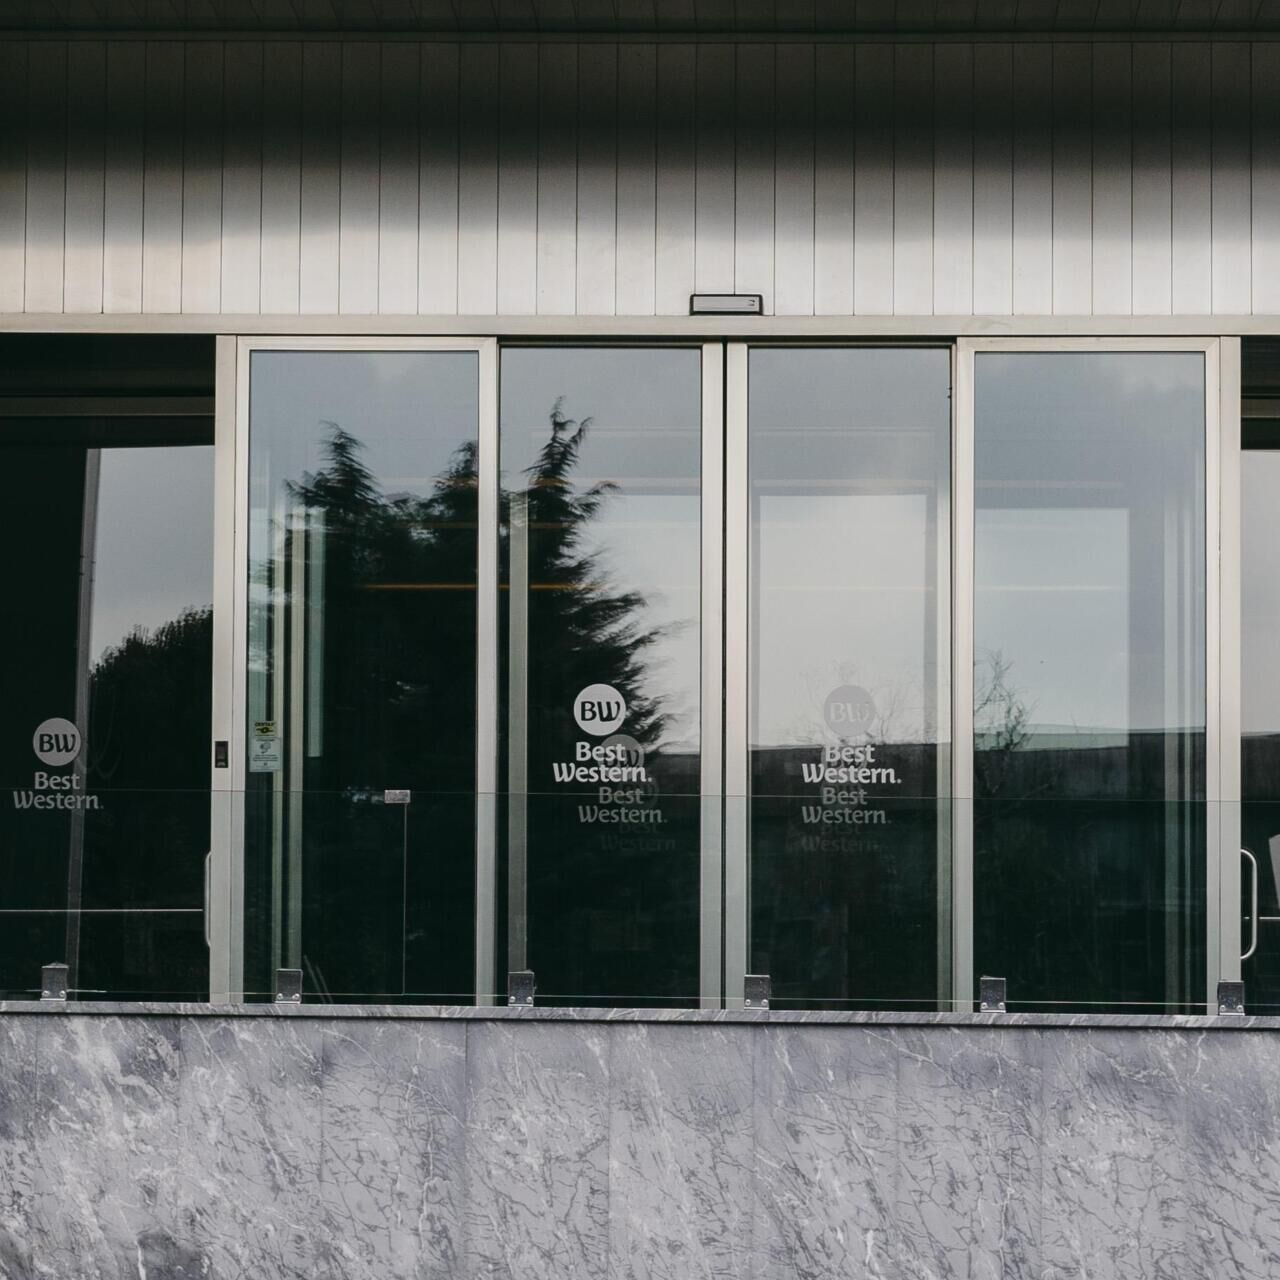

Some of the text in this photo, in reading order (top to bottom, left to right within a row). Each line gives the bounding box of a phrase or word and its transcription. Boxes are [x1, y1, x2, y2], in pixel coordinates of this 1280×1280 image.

[580, 700, 621, 722] BW
[39, 733, 77, 753] BW
[575, 741, 627, 762] Best
[825, 744, 876, 763] Best
[34, 771, 81, 790] Best
[599, 786, 645, 805] Best
[822, 787, 868, 805] Best
